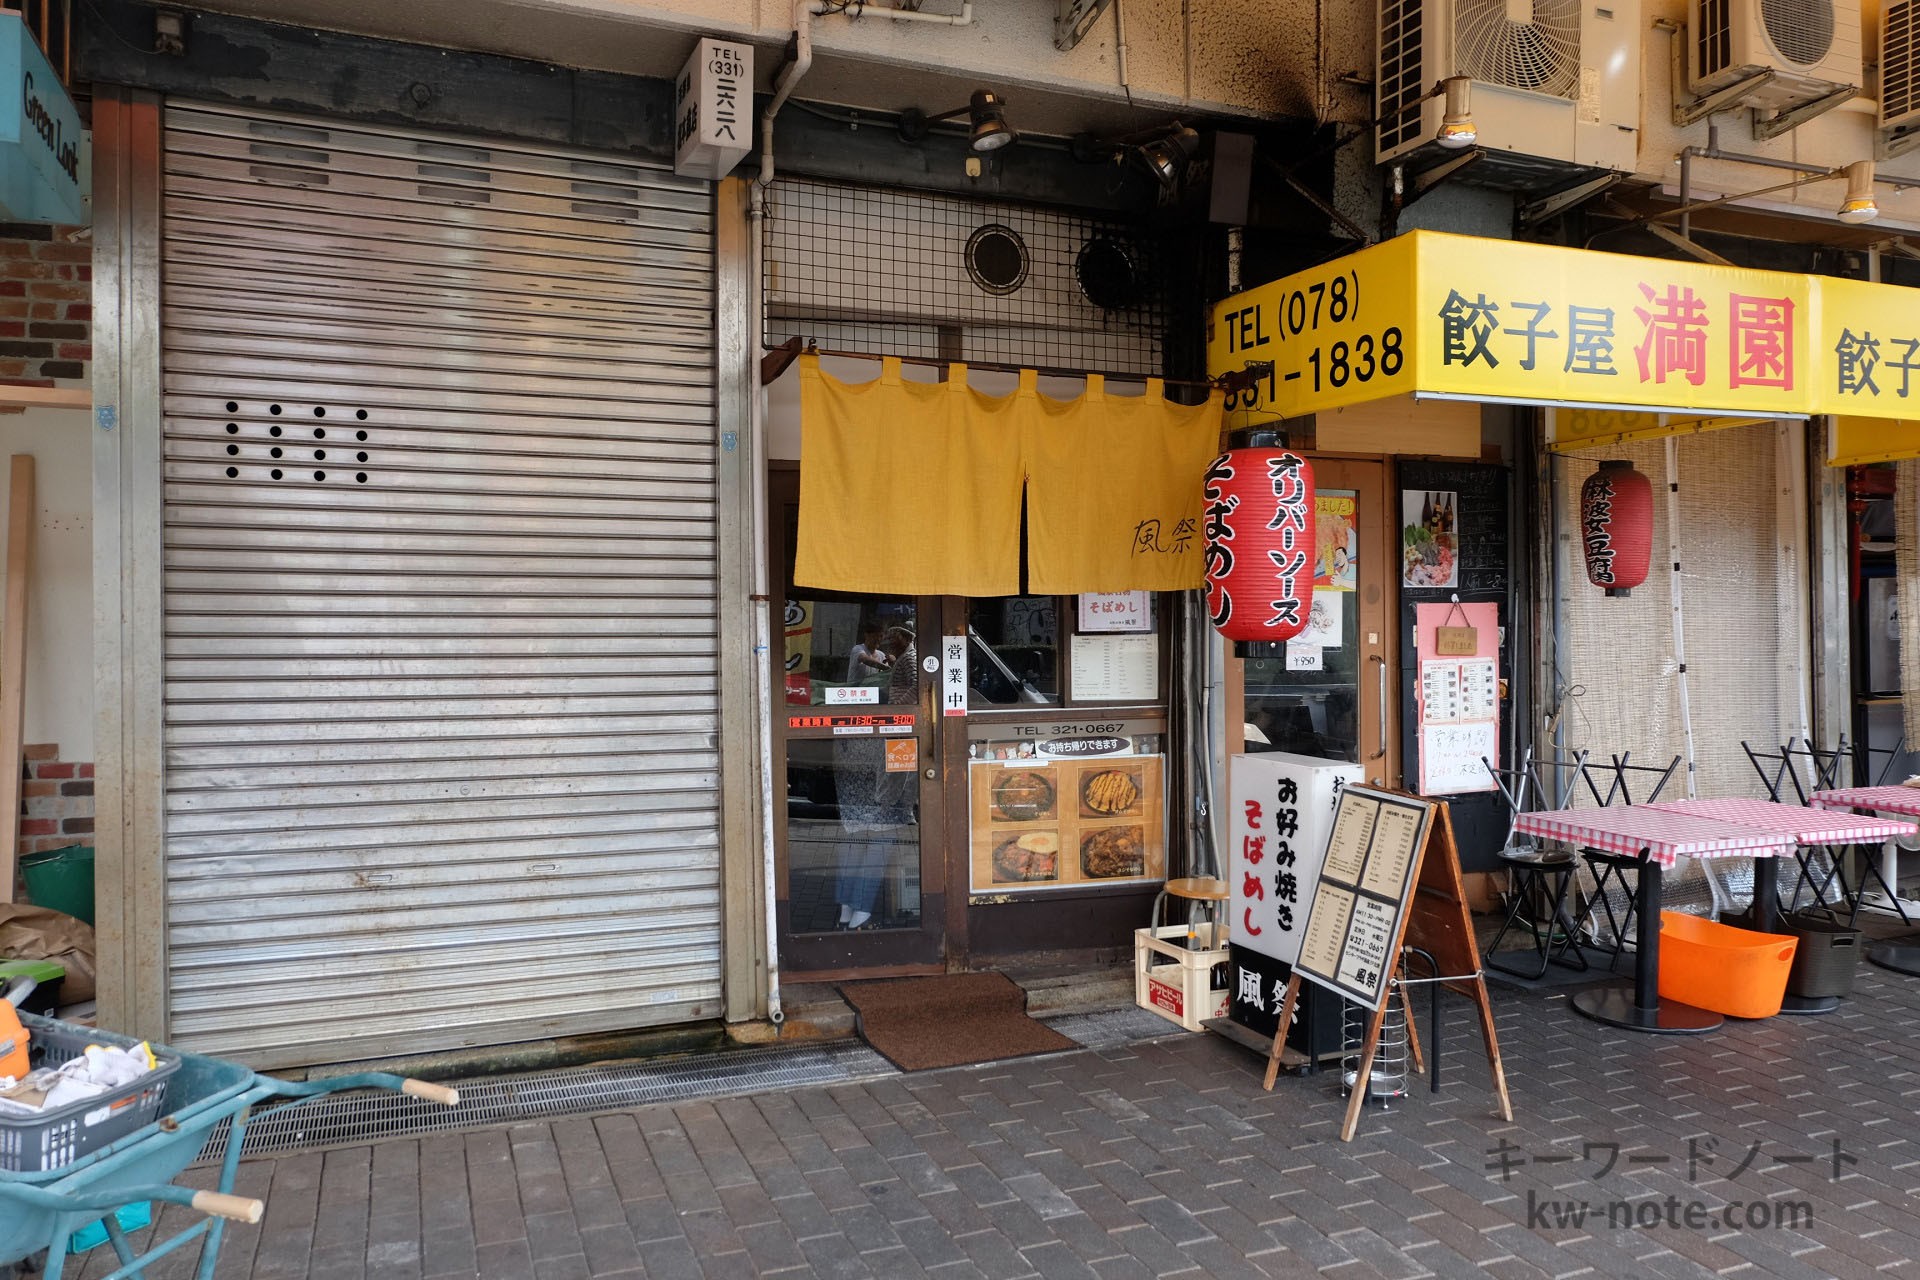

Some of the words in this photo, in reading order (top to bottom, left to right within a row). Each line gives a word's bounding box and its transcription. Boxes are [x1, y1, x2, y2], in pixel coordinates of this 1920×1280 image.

[708, 60, 744, 77] (331)
[712, 47, 741, 60] TEL
[24, 71, 55, 151] Green
[715, 78, 737, 140] 二六二八
[1225, 304, 1270, 353] TEL
[1279, 269, 1359, 341] (078)
[1438, 281, 1795, 391] 餃子屋満園
[1834, 327, 1920, 398] 餃子
[1131, 518, 1197, 560] 風祭
[1203, 453, 1240, 628] そばめし
[1264, 453, 1308, 627] オリバーソース
[1089, 601, 1138, 613] そばめし
[947, 643, 963, 708] 営業中
[1293, 656, 1316, 666] ¥950
[1014, 726, 1045, 735] TEL
[1048, 739, 1118, 753] お持ち帰りできます
[1243, 800, 1266, 936] そばめし
[1274, 777, 1298, 932] お好み焼き
[1149, 981, 1183, 1005] アサヒビール
